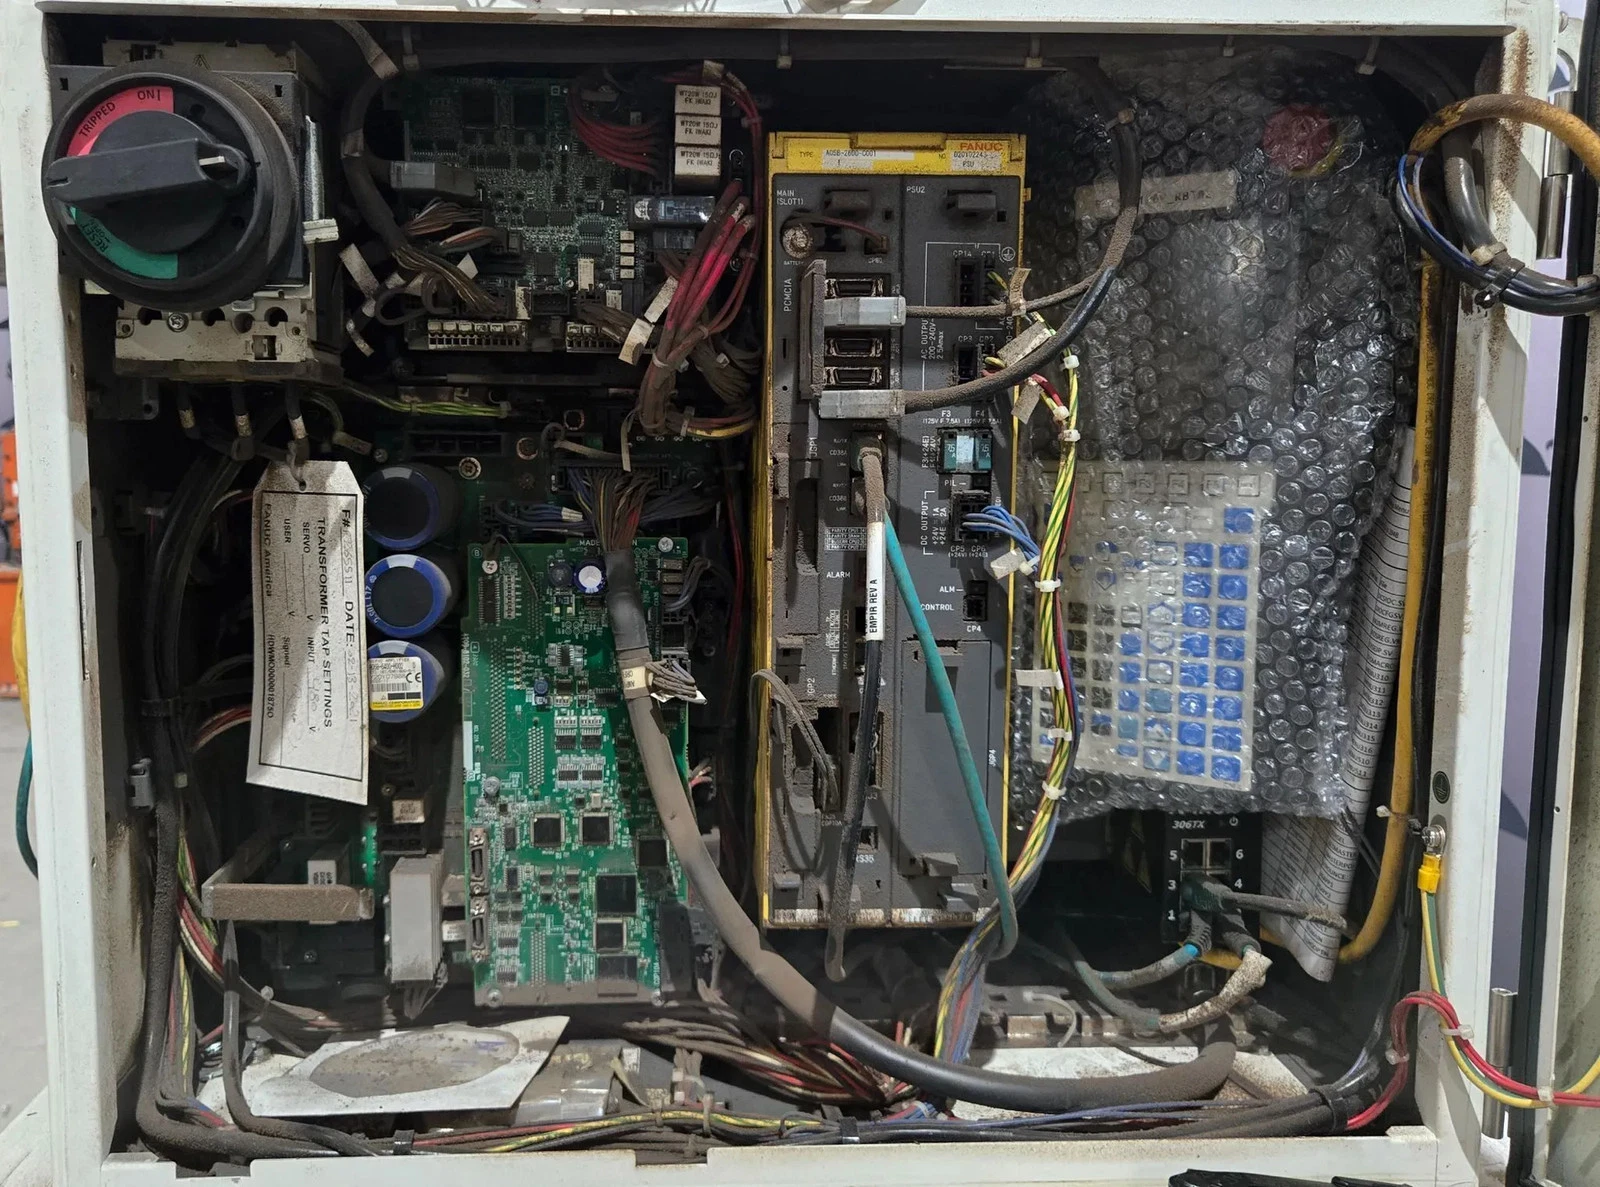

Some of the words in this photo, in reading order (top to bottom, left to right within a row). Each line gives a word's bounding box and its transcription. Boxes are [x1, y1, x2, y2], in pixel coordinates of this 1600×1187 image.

[137, 89, 155, 101] ON
[78, 101, 116, 138] TRIPPED
[960, 142, 1004, 151] FANUC
[962, 160, 975, 168] PSU
[776, 189, 795, 197] MAIN
[906, 186, 926, 194] PSU2
[783, 278, 792, 312] PCMCIA
[921, 317, 929, 345] OUTPU
[921, 349, 928, 359] AC
[941, 410, 952, 418] F3
[341, 509, 352, 527] F#
[921, 500, 929, 531] OUTPUT
[932, 507, 940, 517] 1A
[940, 507, 947, 517] 2A
[264, 503, 273, 546] FANUC
[920, 535, 928, 546] DC
[264, 548, 274, 597] America
[317, 517, 330, 625] TRANSFORMER
[302, 521, 311, 554] SERVO
[307, 636, 315, 664] INPUT
[869, 587, 878, 604] REV
[920, 603, 955, 611] CONTROL
[345, 600, 355, 648] DATE:
[869, 606, 878, 633] EMPIR
[966, 625, 982, 633] CP4
[321, 628, 330, 657] TAP
[282, 636, 291, 668] Signed:
[323, 659, 333, 728] SETTINGS
[988, 749, 996, 766] JGP4
[1172, 820, 1206, 829] 306TX
[1169, 849, 1178, 861] 5
[1235, 848, 1244, 860] 6
[1167, 879, 1177, 891] 3
[1234, 878, 1243, 889] 4
[1167, 909, 1176, 921] 1
